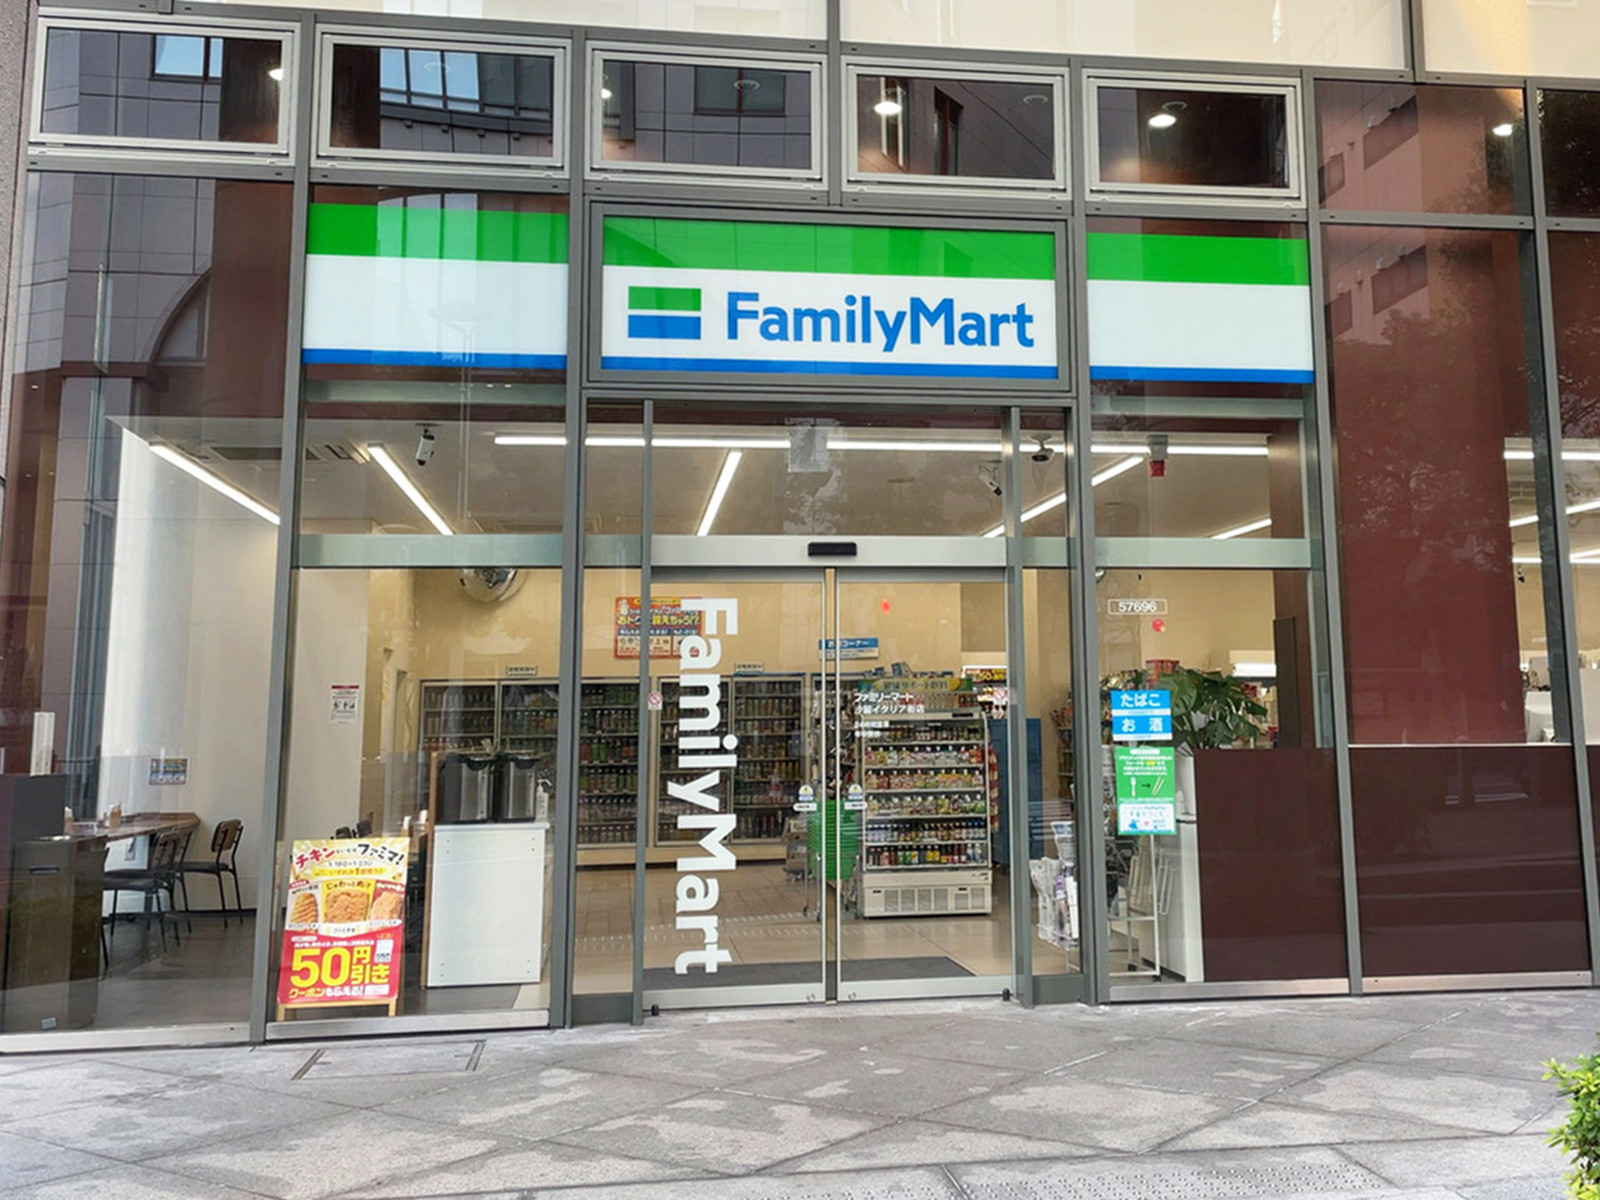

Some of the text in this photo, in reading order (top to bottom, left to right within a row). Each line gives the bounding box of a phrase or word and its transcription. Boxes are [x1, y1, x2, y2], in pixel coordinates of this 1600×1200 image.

[727, 292, 1034, 352] FamilyMart
[1118, 601, 1157, 613] 57696
[1120, 693, 1161, 707] たばこ
[667, 598, 738, 976] FamilyMart
